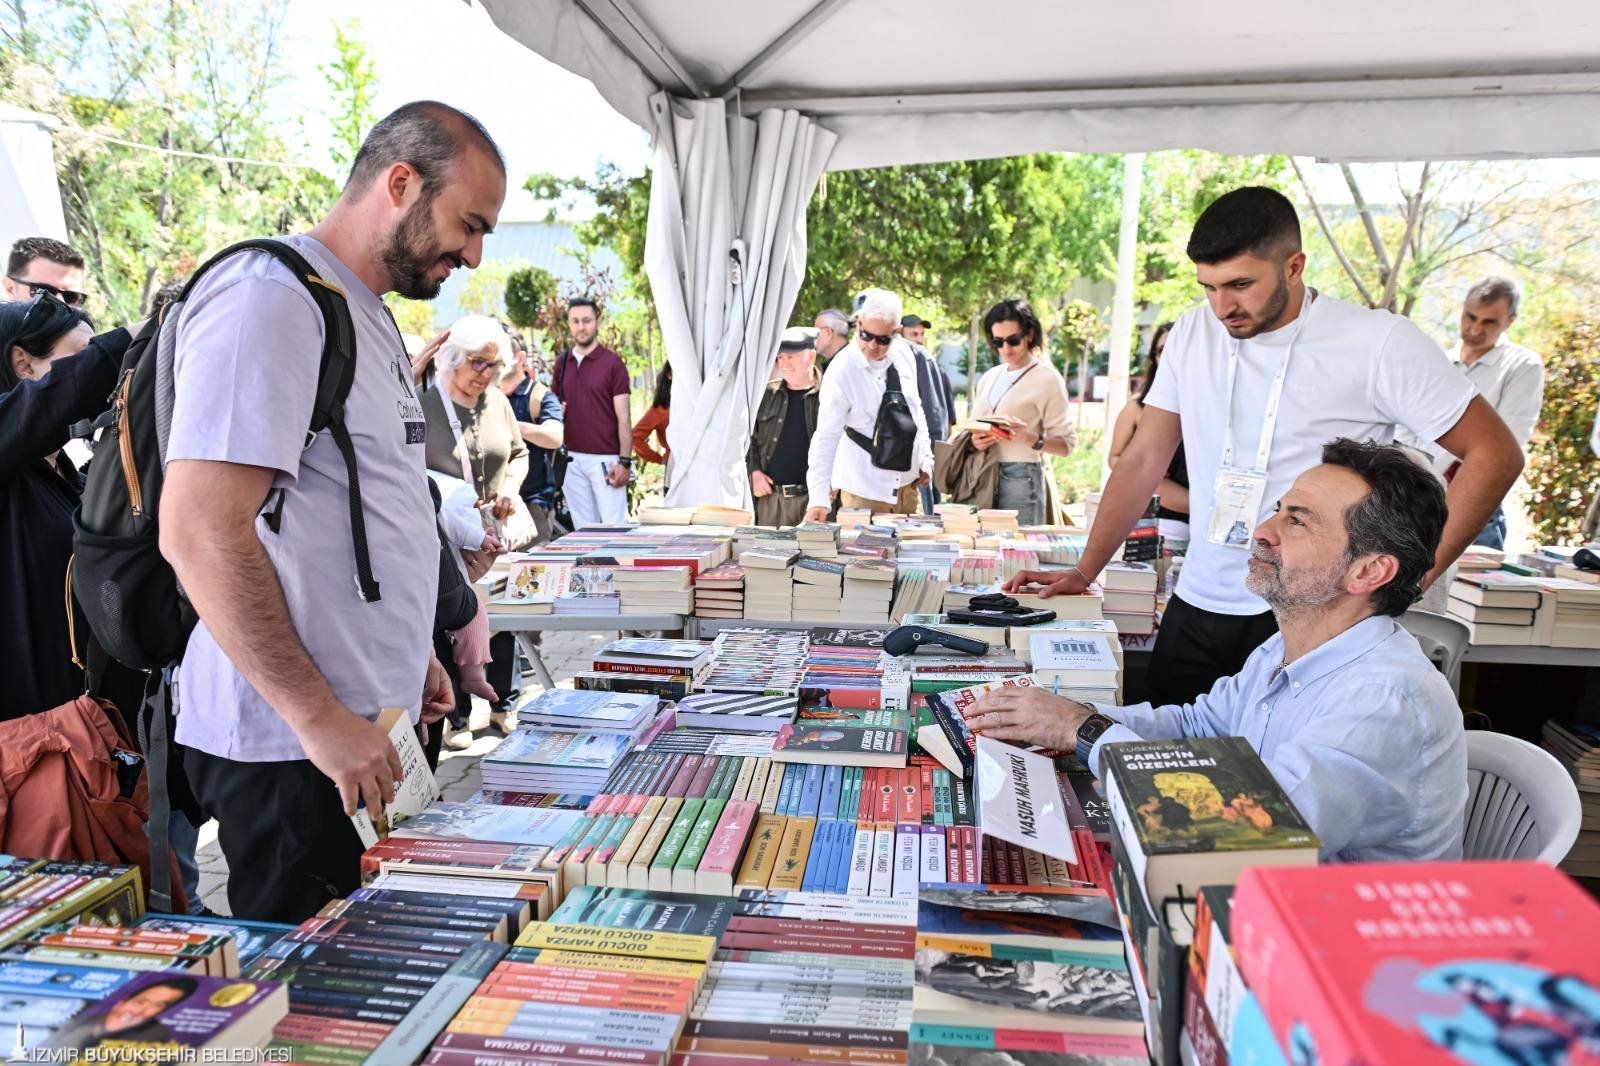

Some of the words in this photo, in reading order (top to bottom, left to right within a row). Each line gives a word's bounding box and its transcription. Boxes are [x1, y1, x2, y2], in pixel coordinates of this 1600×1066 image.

[1122, 750, 1194, 762] PARİS'İN
[1126, 757, 1217, 770] GİZEMLERİ
[1005, 752, 1032, 800] MAHRUKİ
[1016, 800, 1039, 840] NASUH
[758, 841, 768, 852] SON
[553, 925, 601, 938] HAFIZA
[602, 928, 653, 942] GÜÇLÜ
[546, 936, 596, 948] HAFIZA
[598, 939, 648, 952] GÜÇLÜ
[641, 1013, 666, 1021] TONY
[602, 1023, 631, 1032] BUZAN
[635, 1024, 661, 1033] TONY
[595, 1035, 624, 1044] BUZAN
[627, 1036, 654, 1046] TONY
[940, 1031, 990, 1042] CENNET
[483, 1038, 529, 1053] OKUMA
[533, 1042, 566, 1054] HIZLI
